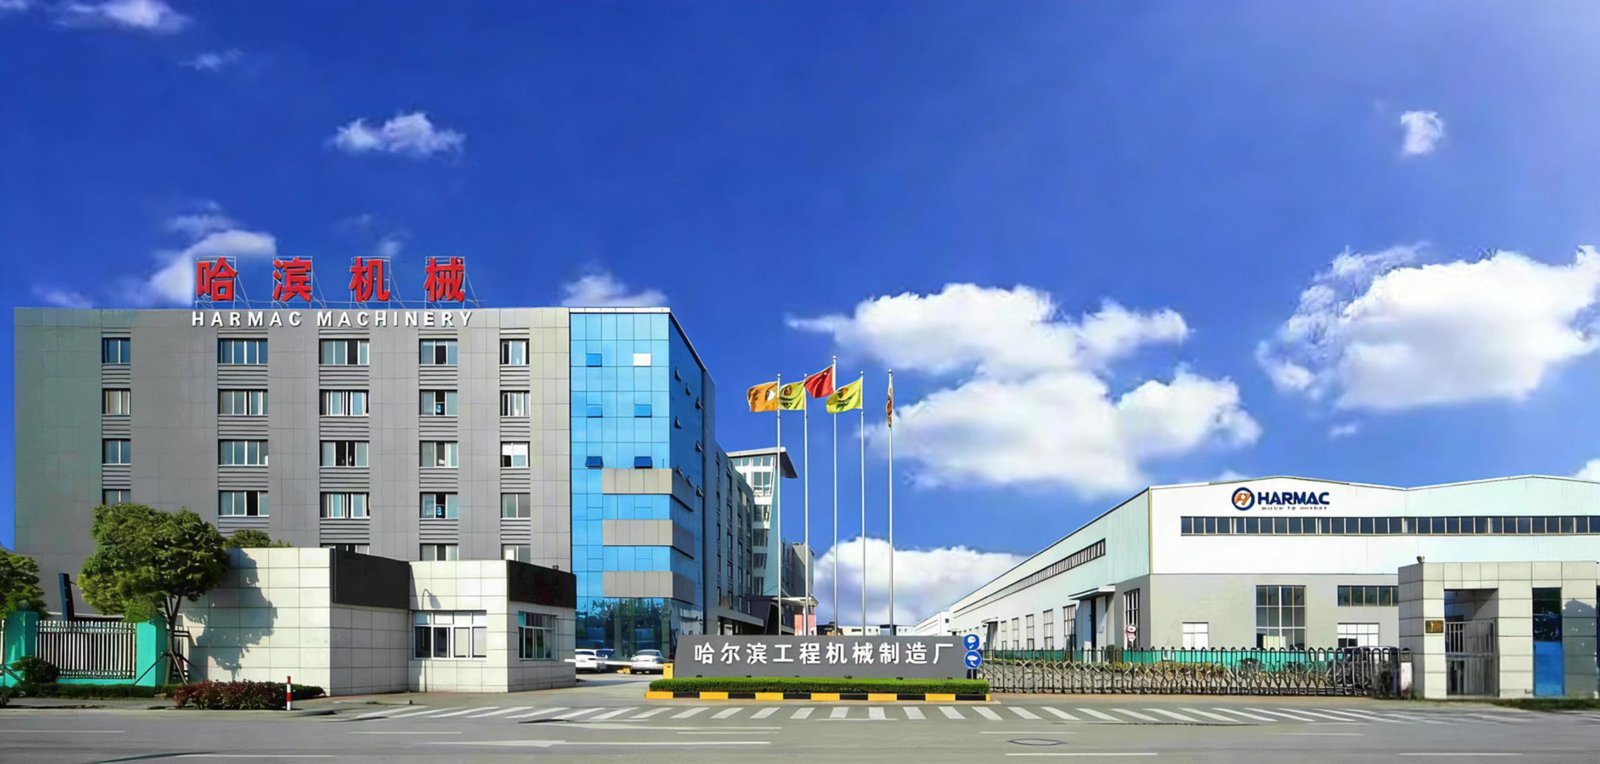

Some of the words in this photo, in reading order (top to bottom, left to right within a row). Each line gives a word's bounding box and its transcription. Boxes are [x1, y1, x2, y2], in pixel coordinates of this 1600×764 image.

[196, 257, 467, 302] 哈滨机械
[192, 311, 302, 327] HARMAC
[317, 310, 474, 327] MACHINERY
[1257, 491, 1330, 505] HARMAC
[694, 641, 954, 665] 哈尔滨工程机械制造厂
